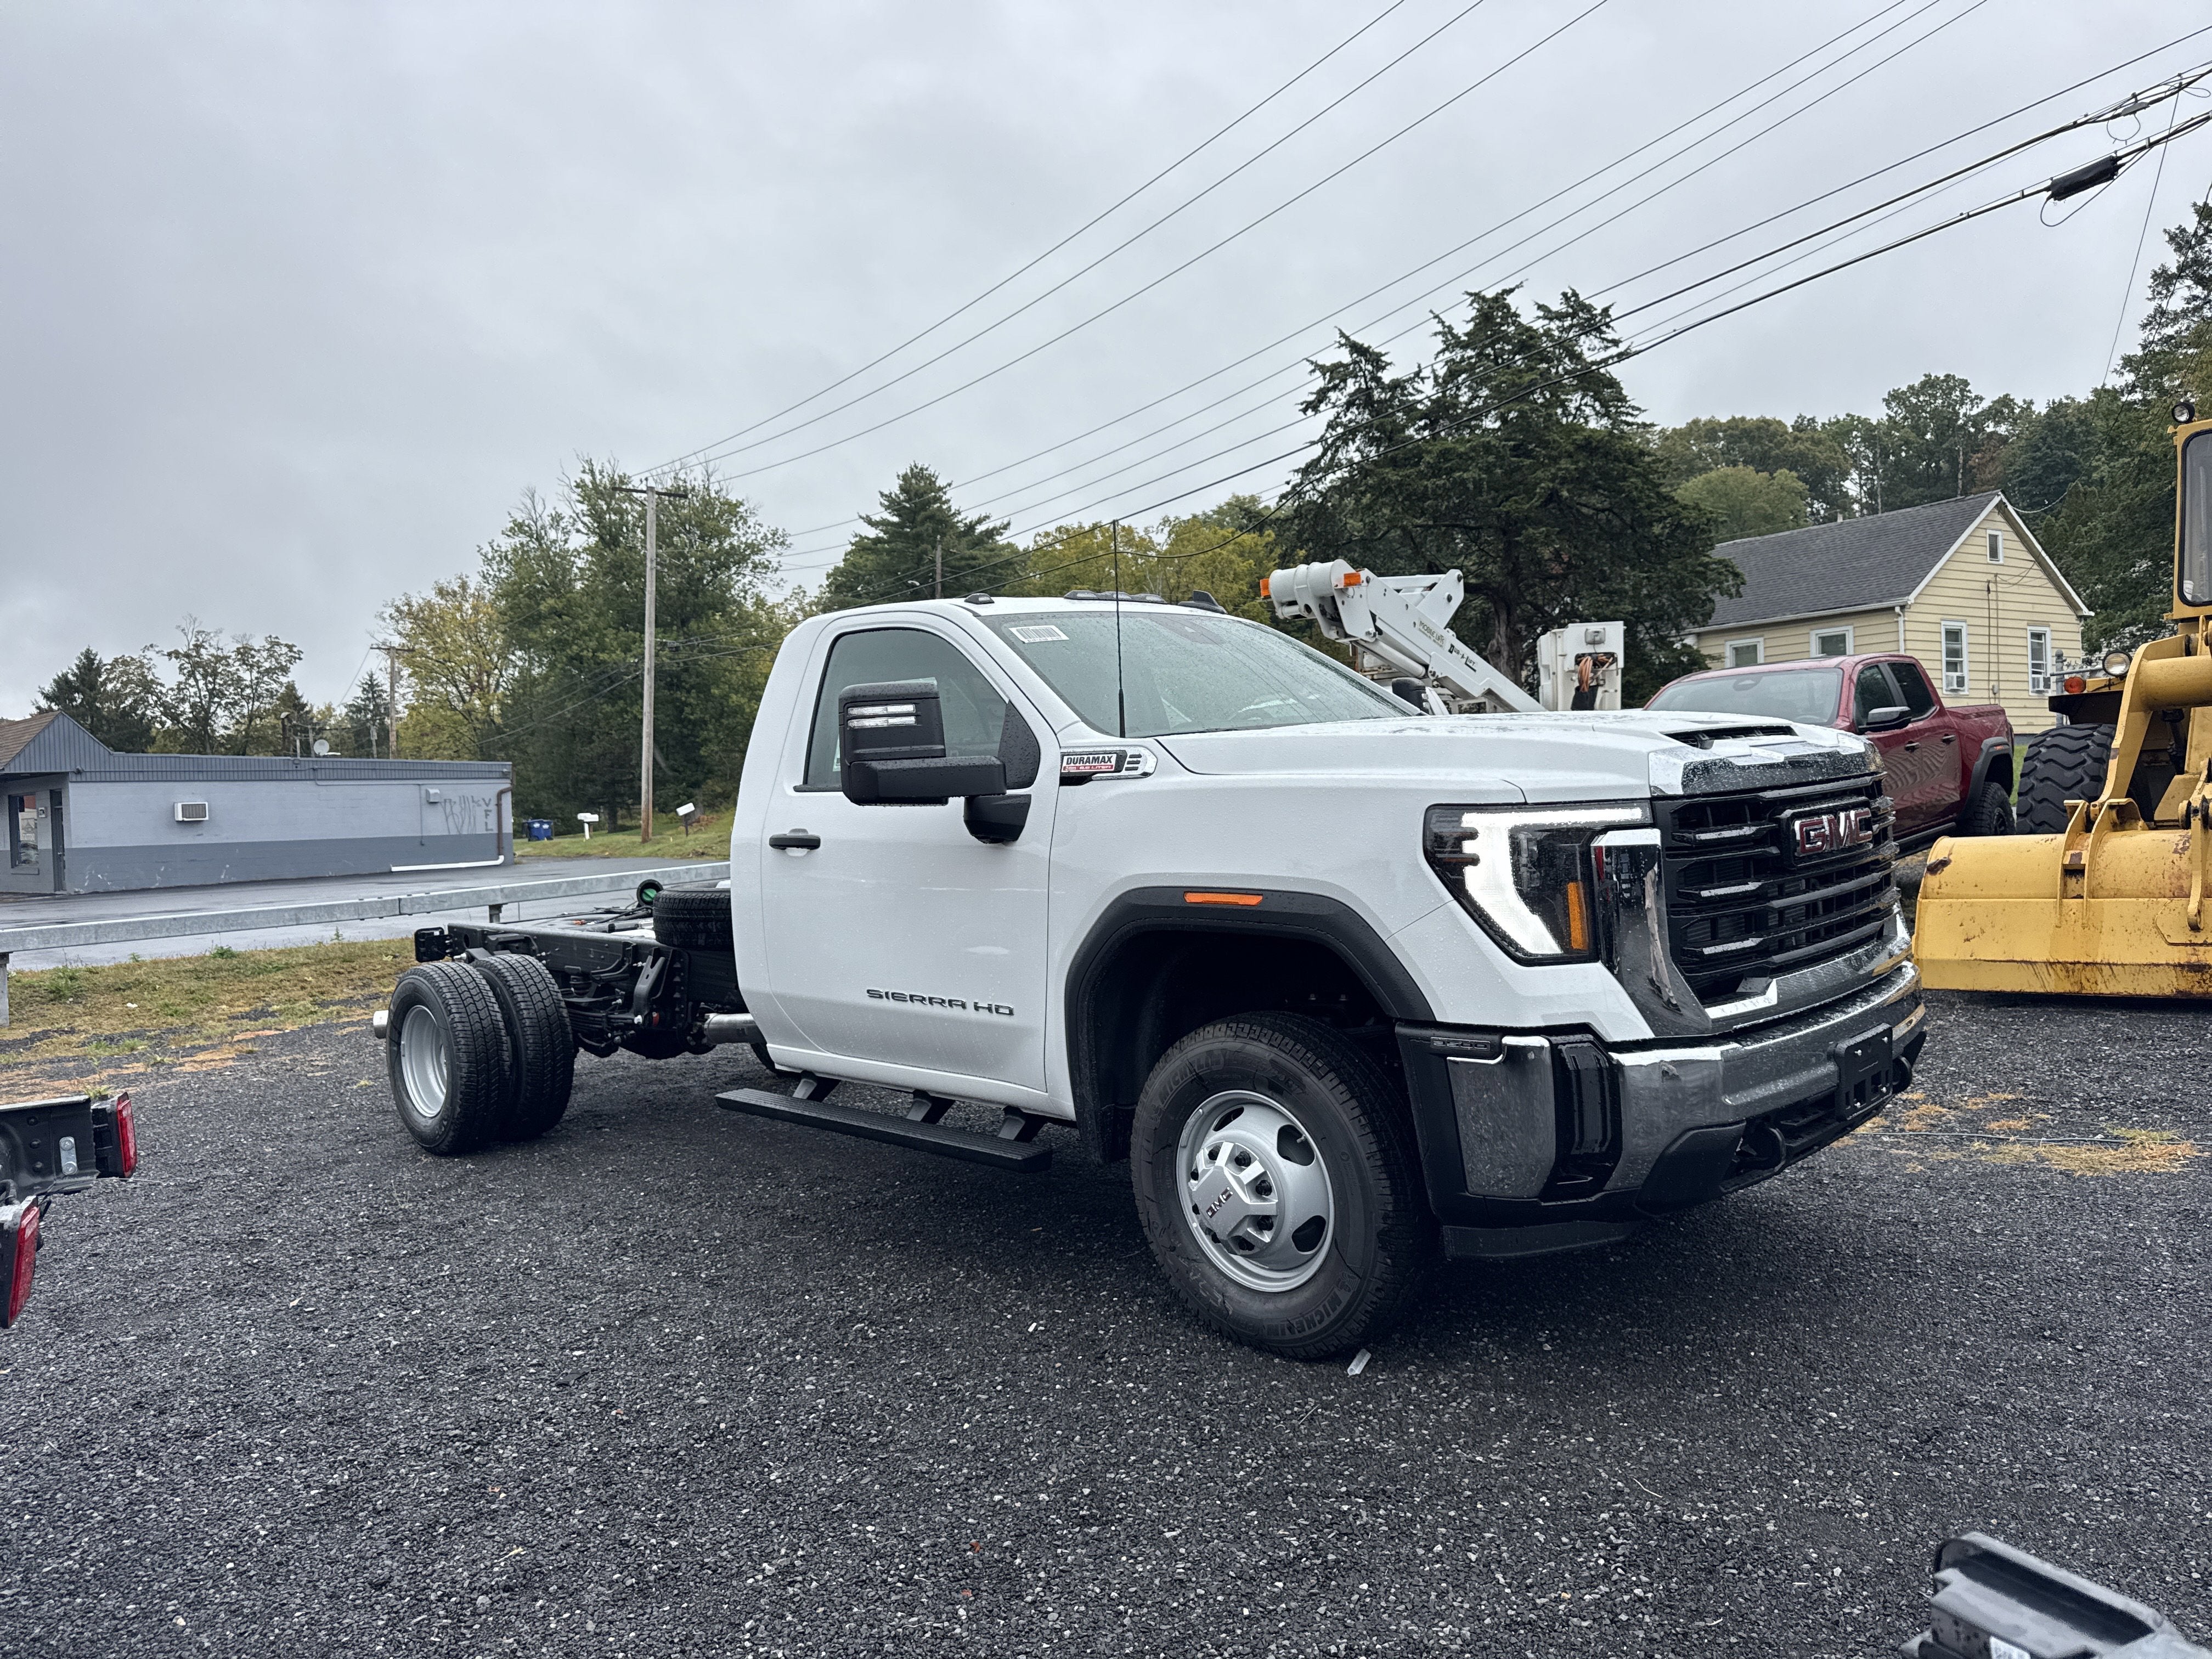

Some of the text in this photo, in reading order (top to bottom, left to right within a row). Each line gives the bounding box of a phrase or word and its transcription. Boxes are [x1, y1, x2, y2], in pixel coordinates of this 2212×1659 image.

[1066, 755, 1114, 765] DURAMAX
[1794, 807, 1873, 857] GMC
[866, 988, 1015, 1015] SIERRA HD
[1206, 1187, 1234, 1218] GMC
[1265, 1291, 1344, 1337] MICHELIN
